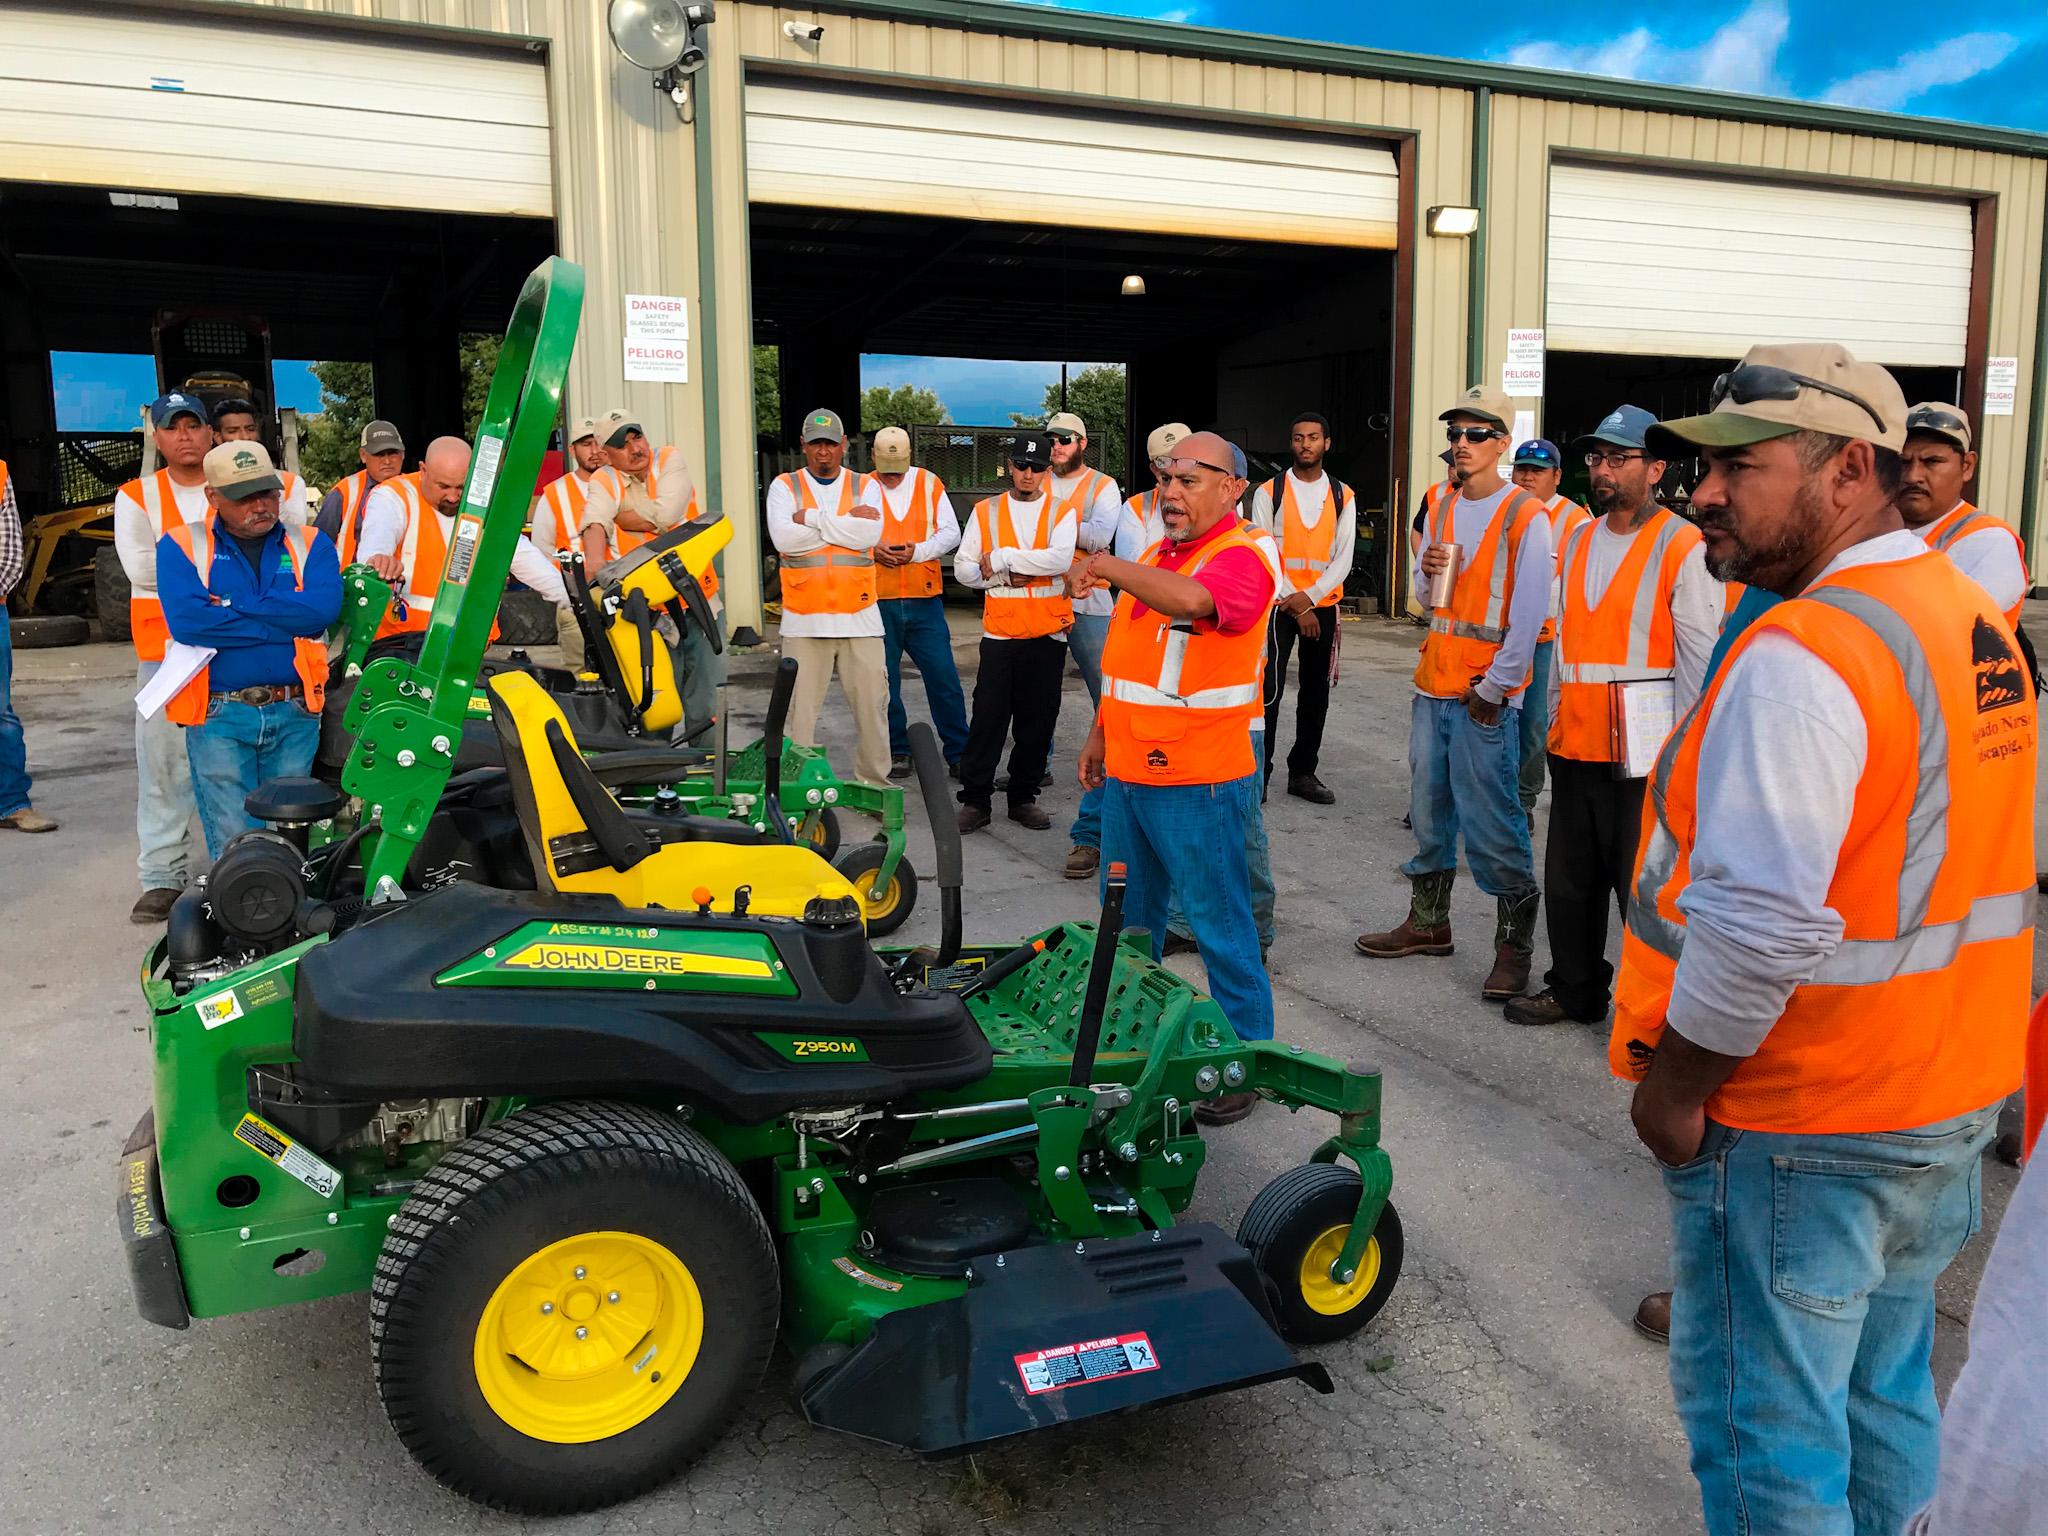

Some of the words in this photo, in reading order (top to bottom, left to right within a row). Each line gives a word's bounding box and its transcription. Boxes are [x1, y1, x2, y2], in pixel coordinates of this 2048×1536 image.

[631, 300, 682, 312] DANGER
[627, 347, 684, 360] PELIGRO
[1504, 370, 1541, 379] PELIGRO
[532, 948, 599, 967] JOHN
[604, 950, 684, 971] DEERE
[1045, 1345, 1076, 1358] DANGER
[1086, 1337, 1119, 1350] PELIGRO
